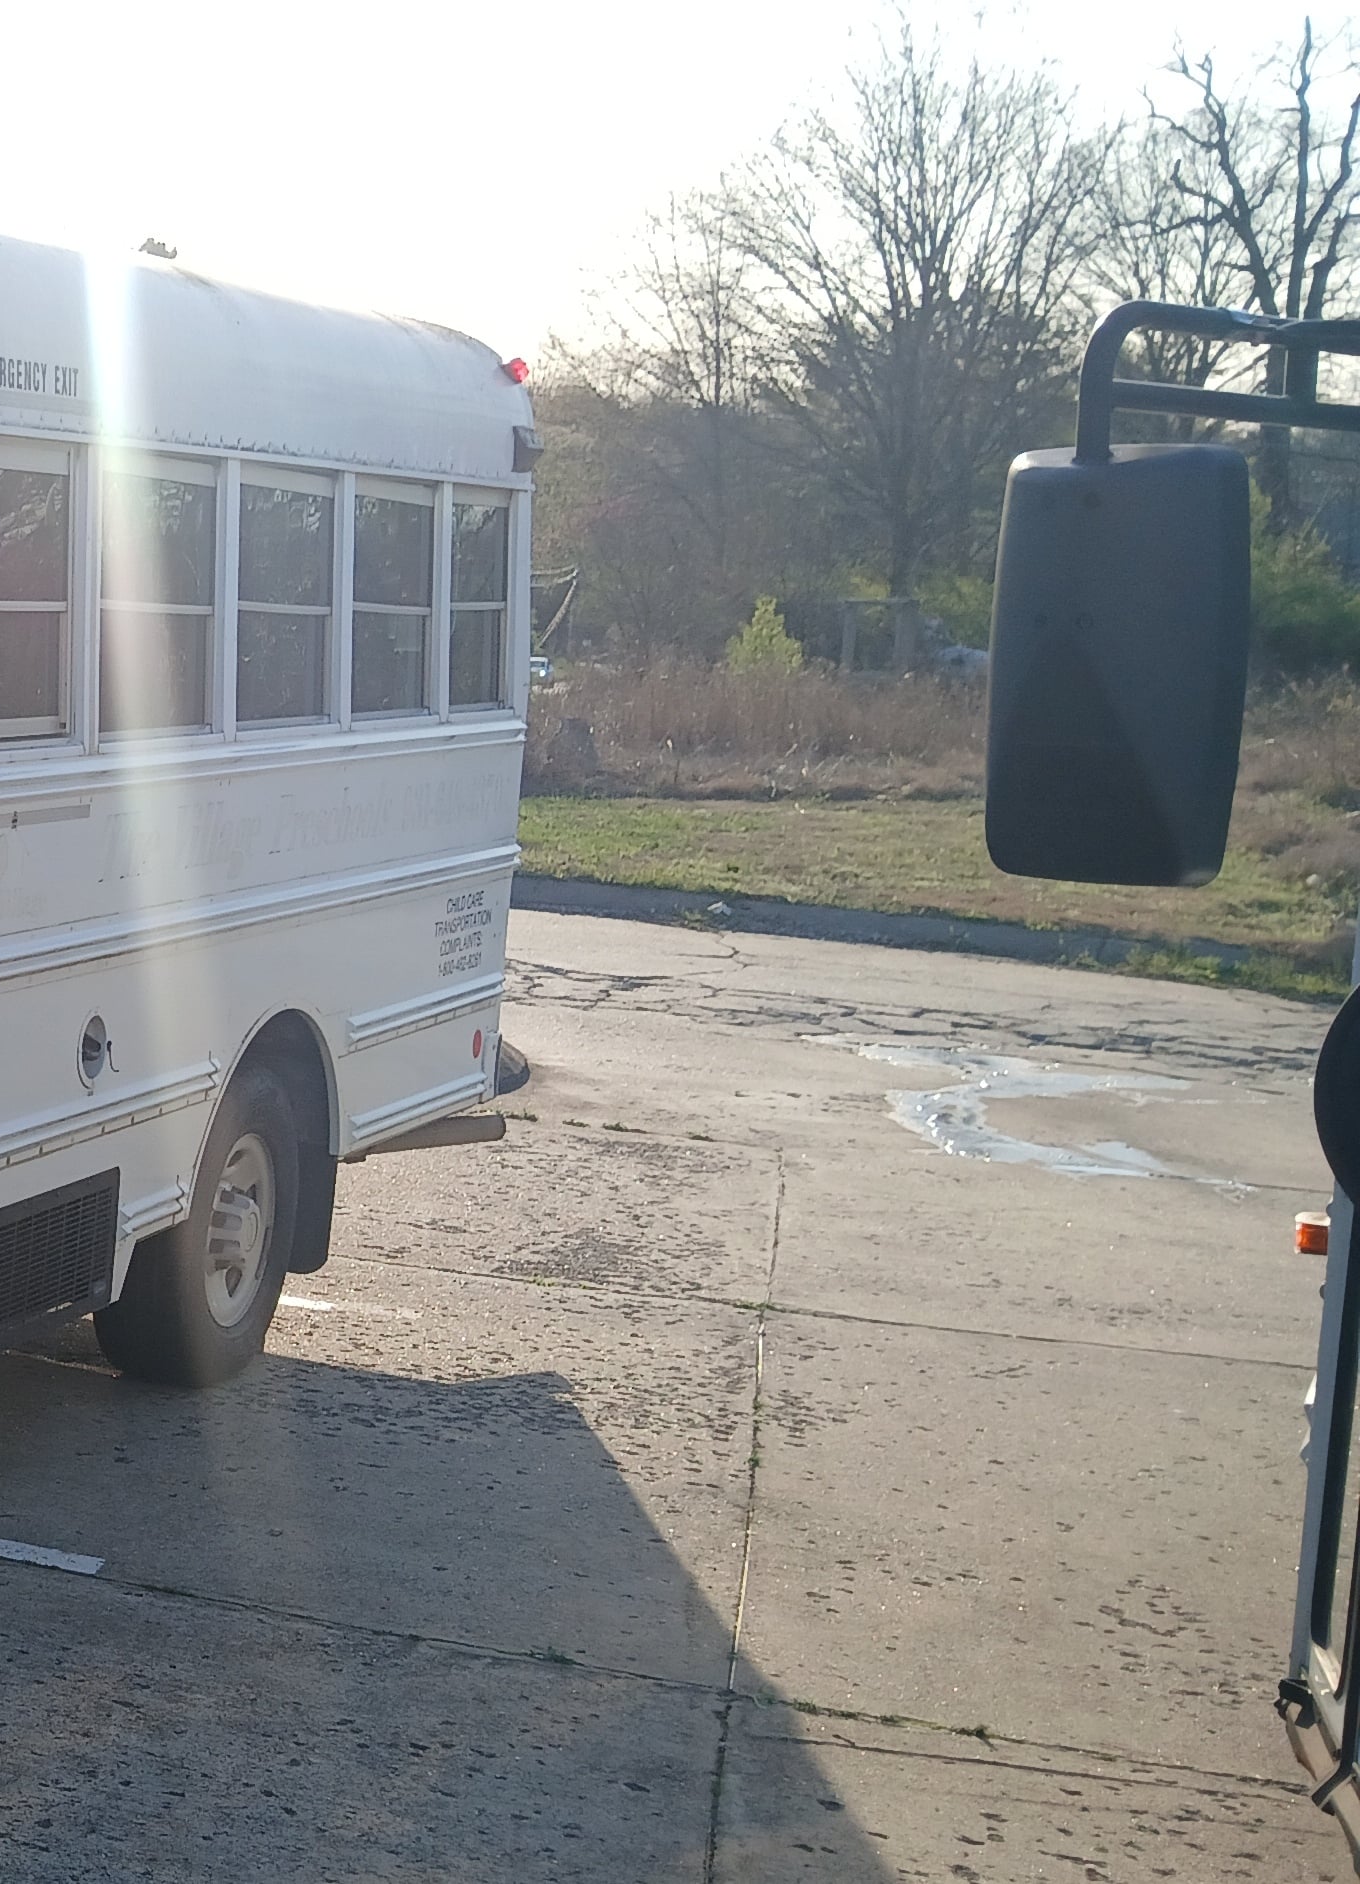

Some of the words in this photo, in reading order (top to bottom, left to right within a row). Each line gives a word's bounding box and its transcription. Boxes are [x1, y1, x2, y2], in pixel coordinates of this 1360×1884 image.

[54, 364, 80, 398] EXIT
[446, 895, 466, 915] CHILD
[466, 890, 485, 910] CARE
[434, 909, 492, 937] TRANSPORTATION
